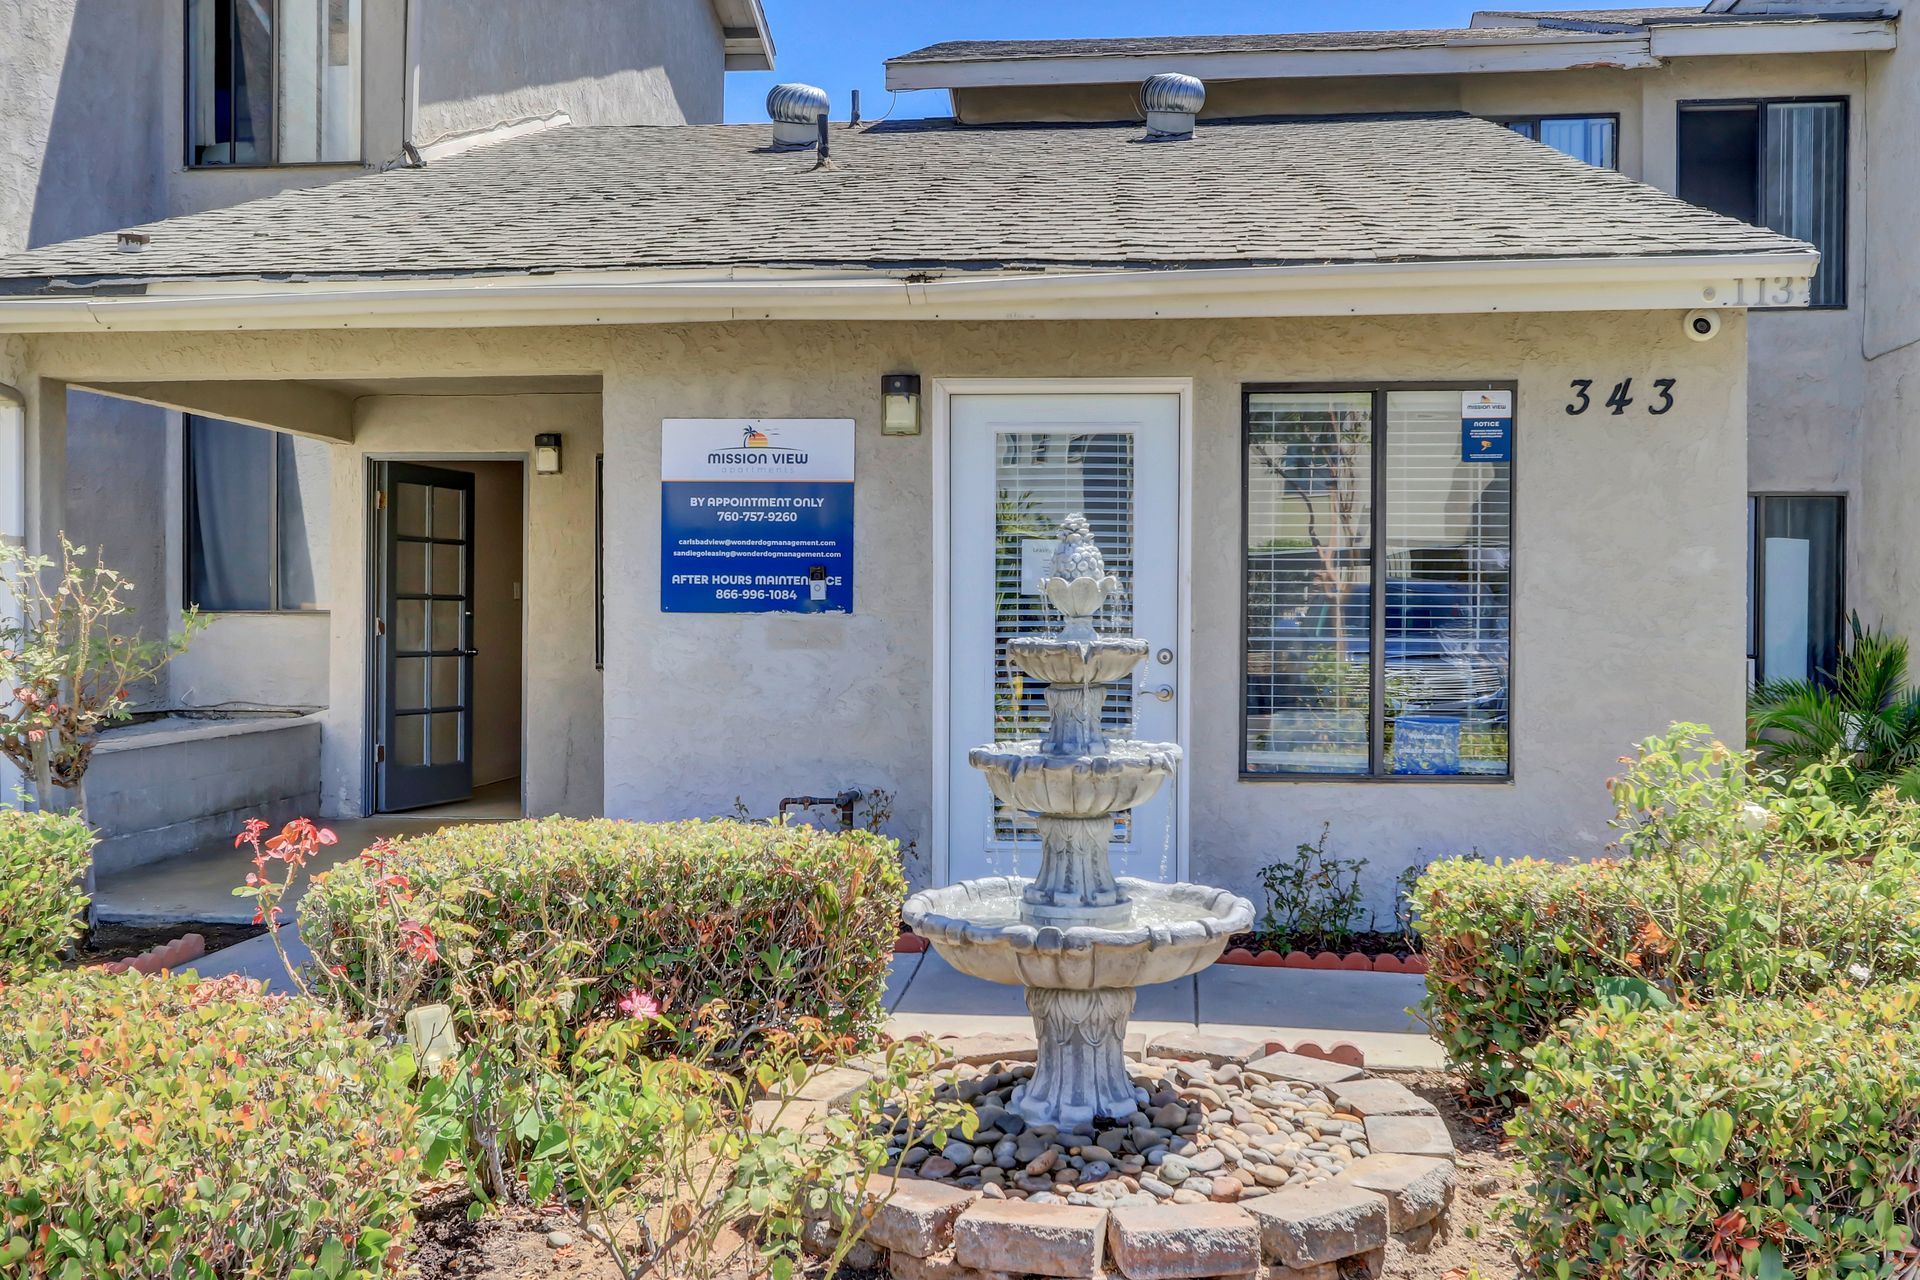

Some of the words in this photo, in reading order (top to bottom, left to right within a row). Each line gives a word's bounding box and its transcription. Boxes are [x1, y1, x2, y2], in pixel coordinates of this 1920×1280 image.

[1565, 377, 1677, 416] 343
[707, 453, 768, 465] MISSION
[772, 453, 809, 465] VIEW
[721, 466, 796, 474] apartments
[690, 497, 706, 507] BY
[707, 497, 791, 507] APPOINTMENT
[793, 498, 825, 508] ONLY
[717, 511, 798, 522] 760-757-9260
[678, 538, 836, 547] carlsbadview@wonderdogmanagement.com
[673, 550, 842, 559] sandiegoleasing@wonderdogmanagement.com
[671, 575, 709, 585] AFTER
[712, 575, 752, 586] HOURS
[755, 575, 842, 587] MAINTENCE
[715, 589, 798, 600] 866-996-1084
